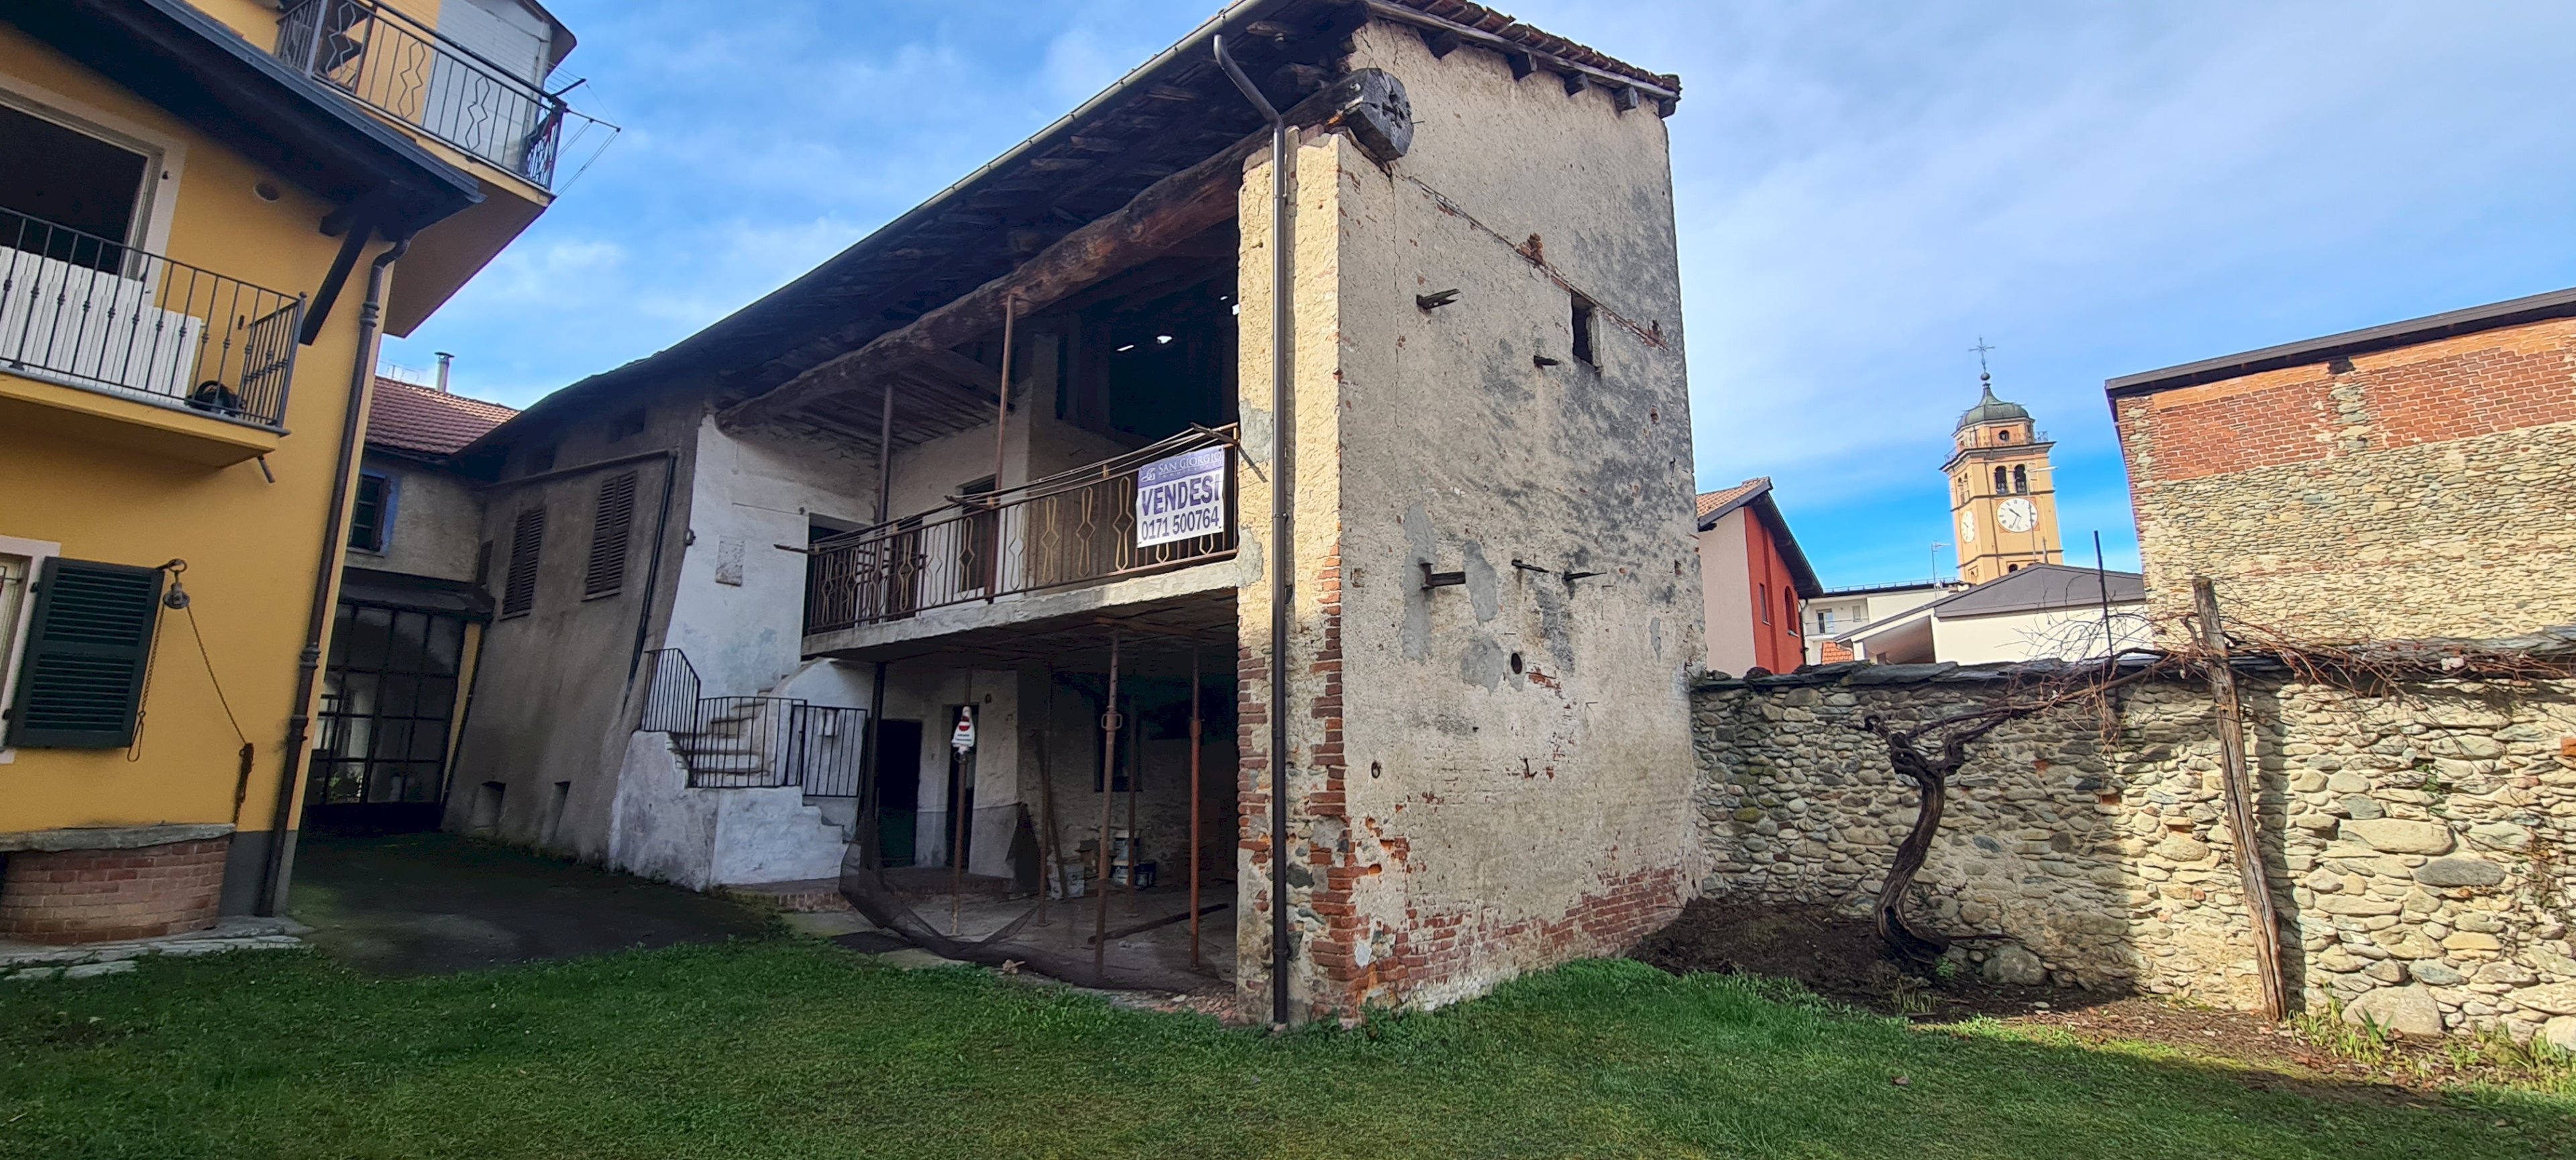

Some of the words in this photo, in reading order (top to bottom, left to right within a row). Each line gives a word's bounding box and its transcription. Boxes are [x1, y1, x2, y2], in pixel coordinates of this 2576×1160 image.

[1158, 461, 1177, 474] SAN
[1179, 452, 1222, 468] GIORGIO
[1141, 473, 1220, 516] VENDESI
[1141, 517, 1170, 541] 0171
[1173, 506, 1220, 535] 500764
